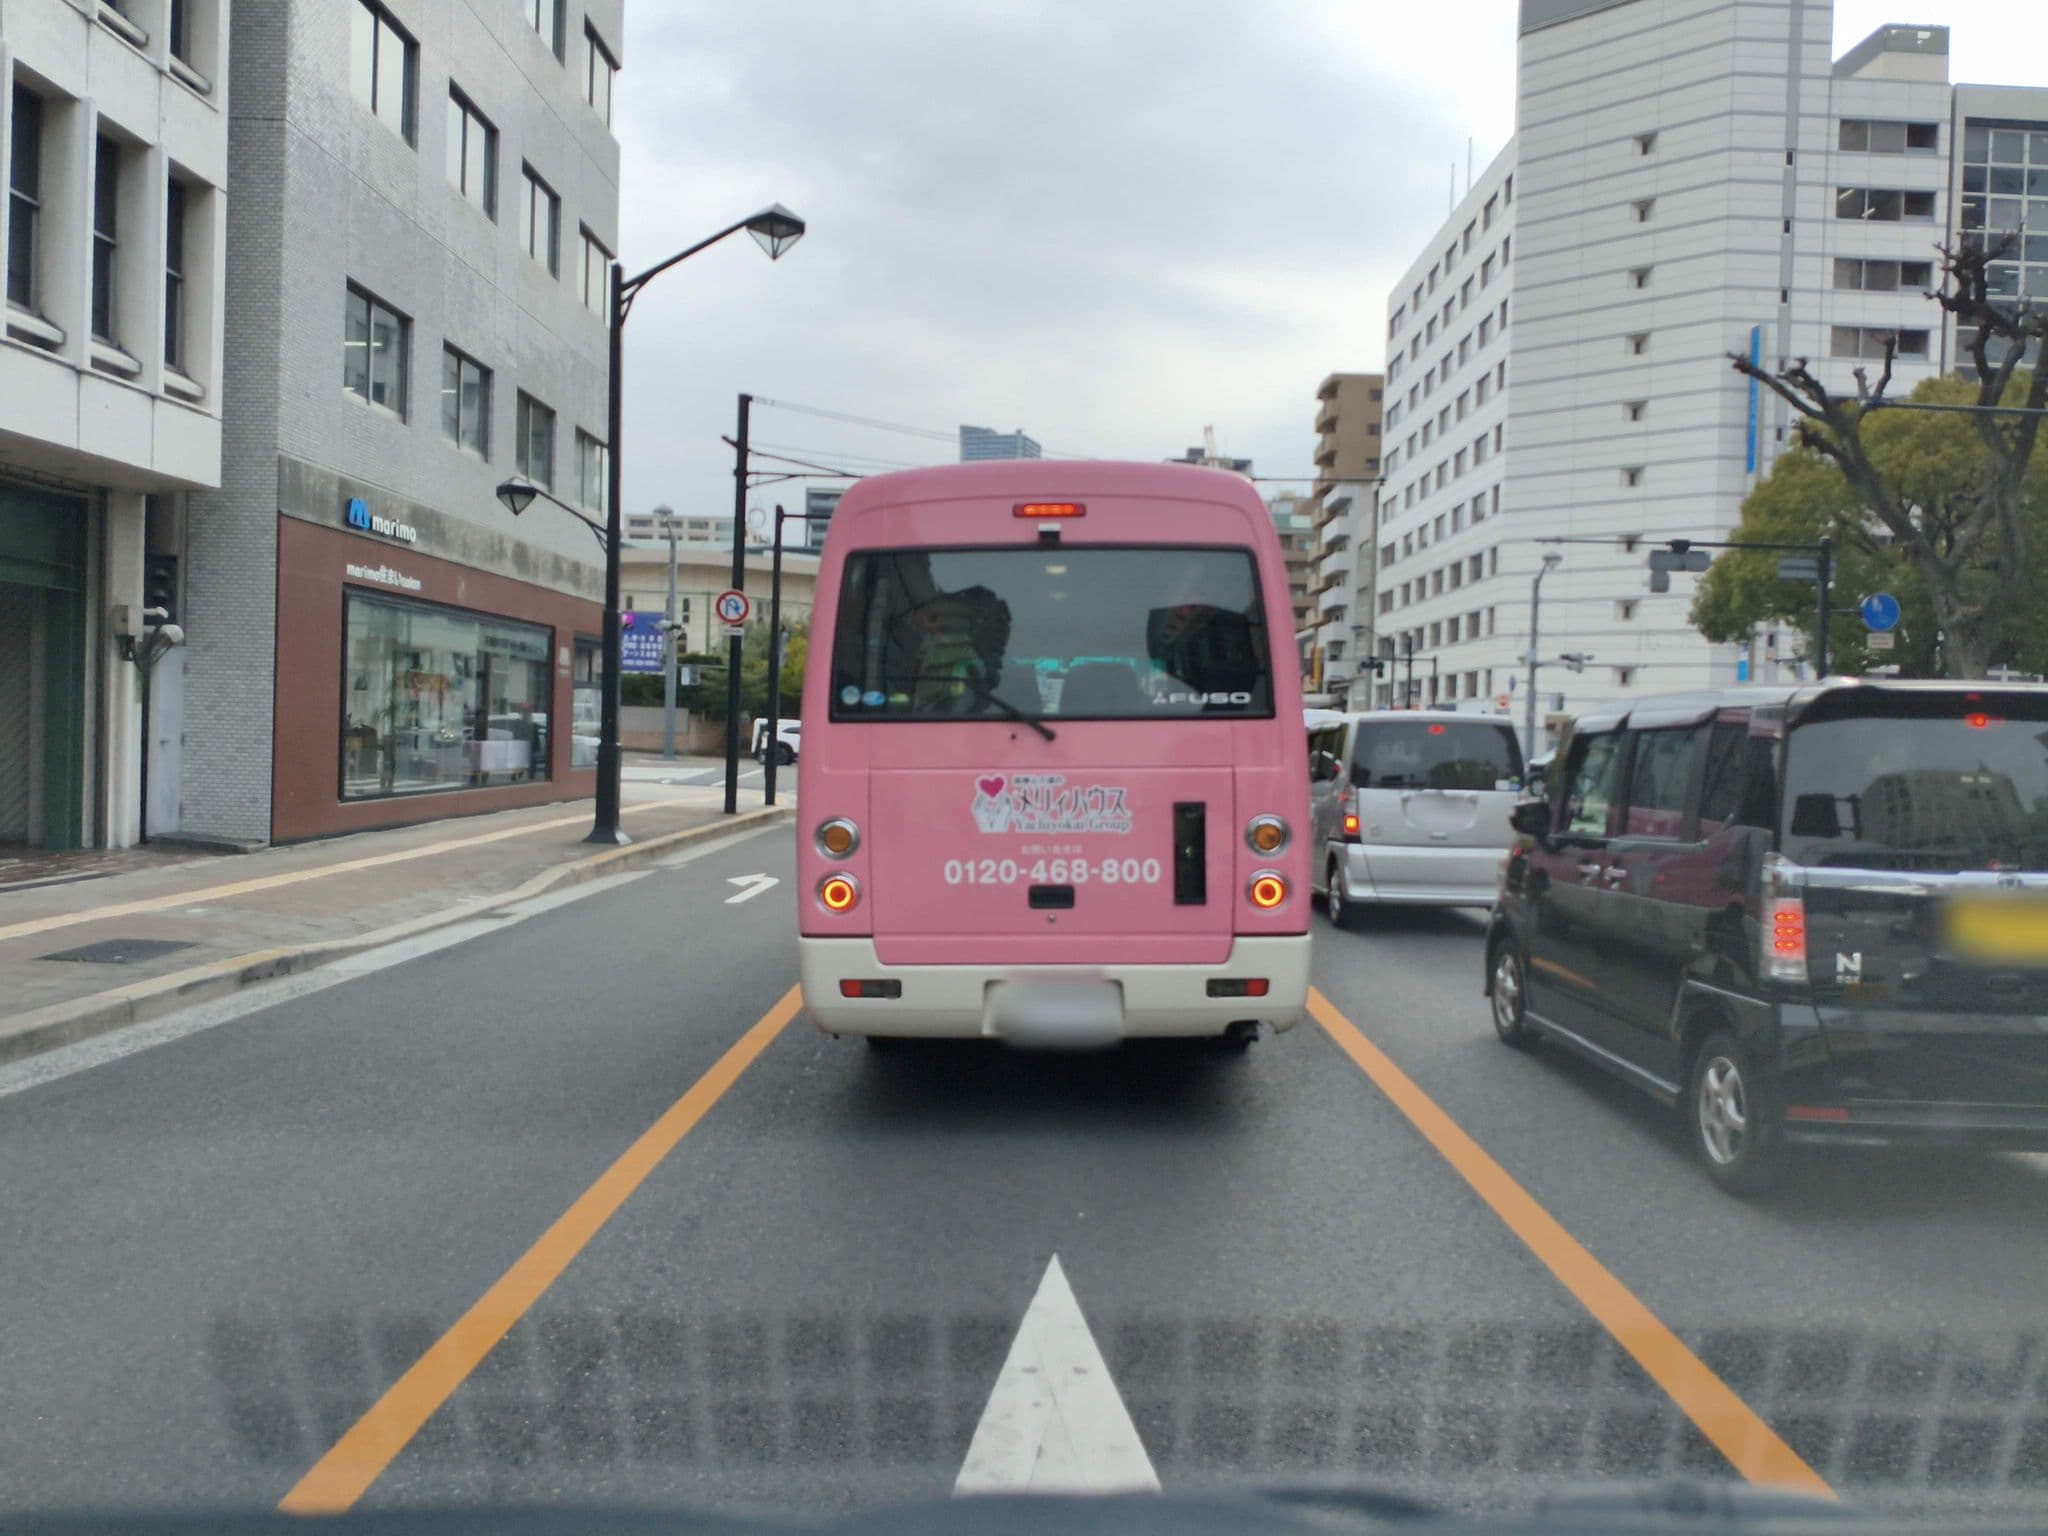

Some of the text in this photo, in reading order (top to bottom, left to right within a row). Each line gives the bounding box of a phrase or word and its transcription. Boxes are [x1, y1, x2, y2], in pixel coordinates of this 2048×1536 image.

[372, 516, 417, 542] marimo
[1168, 692, 1251, 705] FUSO
[1019, 785, 1127, 816] メリィハウス
[943, 858, 1162, 885] 0120-468-800
